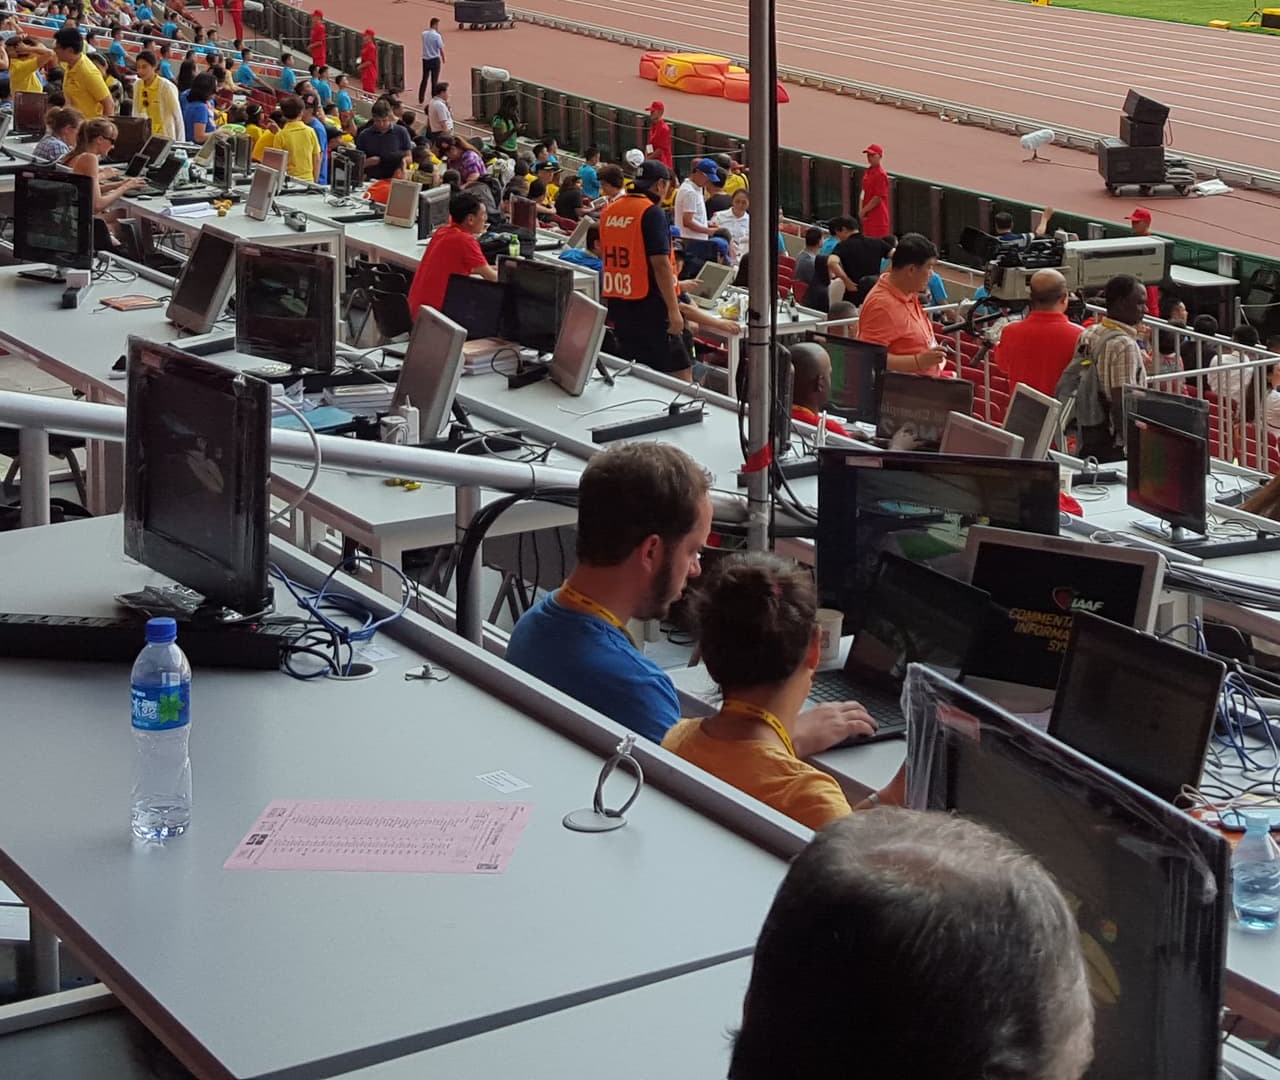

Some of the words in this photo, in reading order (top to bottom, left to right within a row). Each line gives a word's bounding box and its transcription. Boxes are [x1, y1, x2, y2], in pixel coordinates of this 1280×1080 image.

[606, 216, 634, 228] IAAF
[604, 245, 630, 268] HB
[1071, 598, 1104, 611] IAAF
